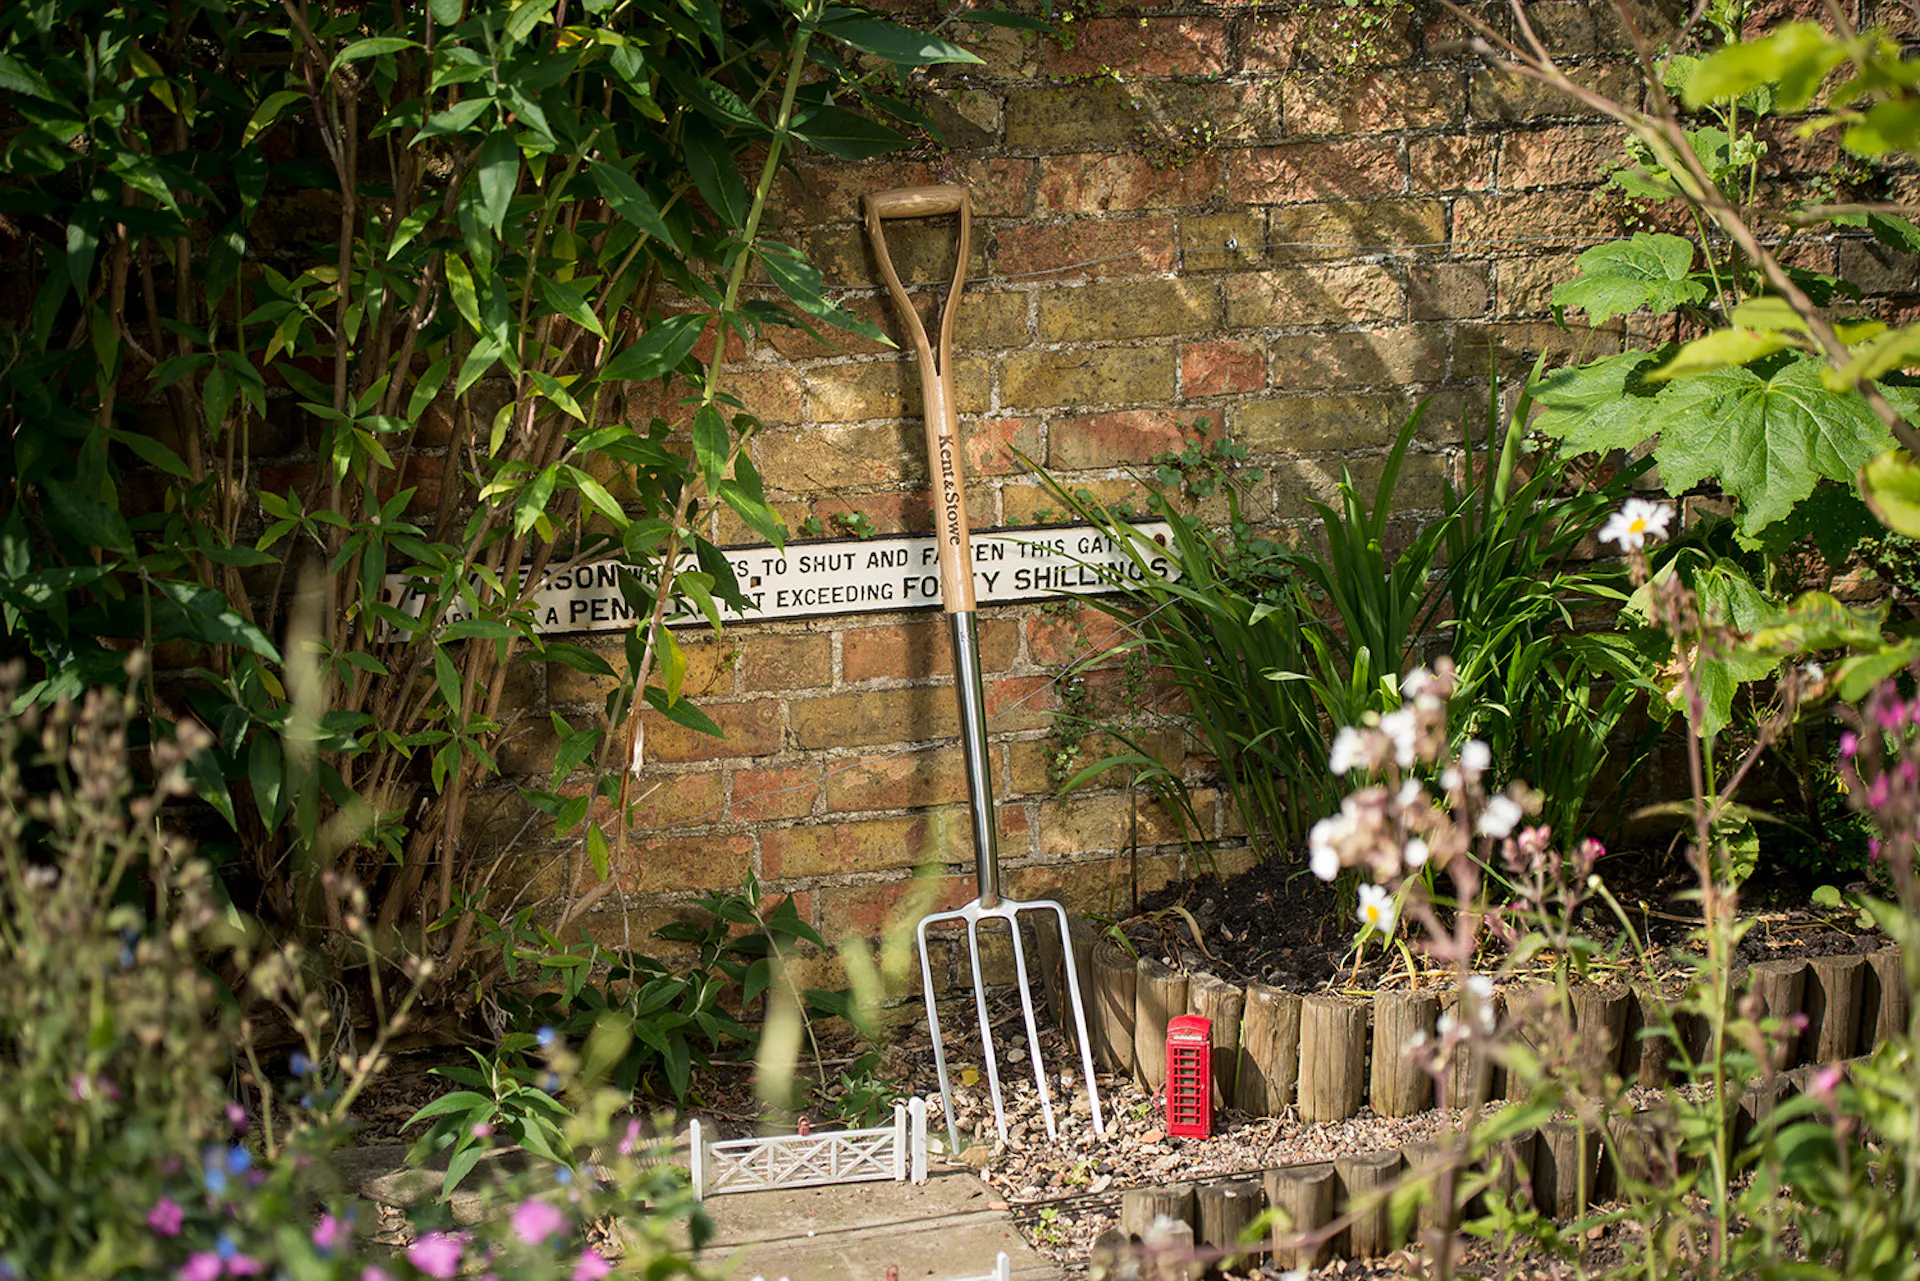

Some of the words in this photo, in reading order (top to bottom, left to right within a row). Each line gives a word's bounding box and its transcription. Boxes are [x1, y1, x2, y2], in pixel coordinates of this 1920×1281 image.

[496, 564, 616, 597] ESON
[762, 557, 787, 576] TO
[799, 553, 856, 574] SHUT
[867, 549, 908, 569] AND
[922, 543, 1004, 565] FEN
[1017, 539, 1064, 558] THIS
[1078, 534, 1132, 554] GAT
[545, 607, 559, 625] A
[777, 584, 893, 608] EXCEEDING
[904, 571, 1000, 598] FOY
[1015, 558, 1167, 590] SHILLINGS
